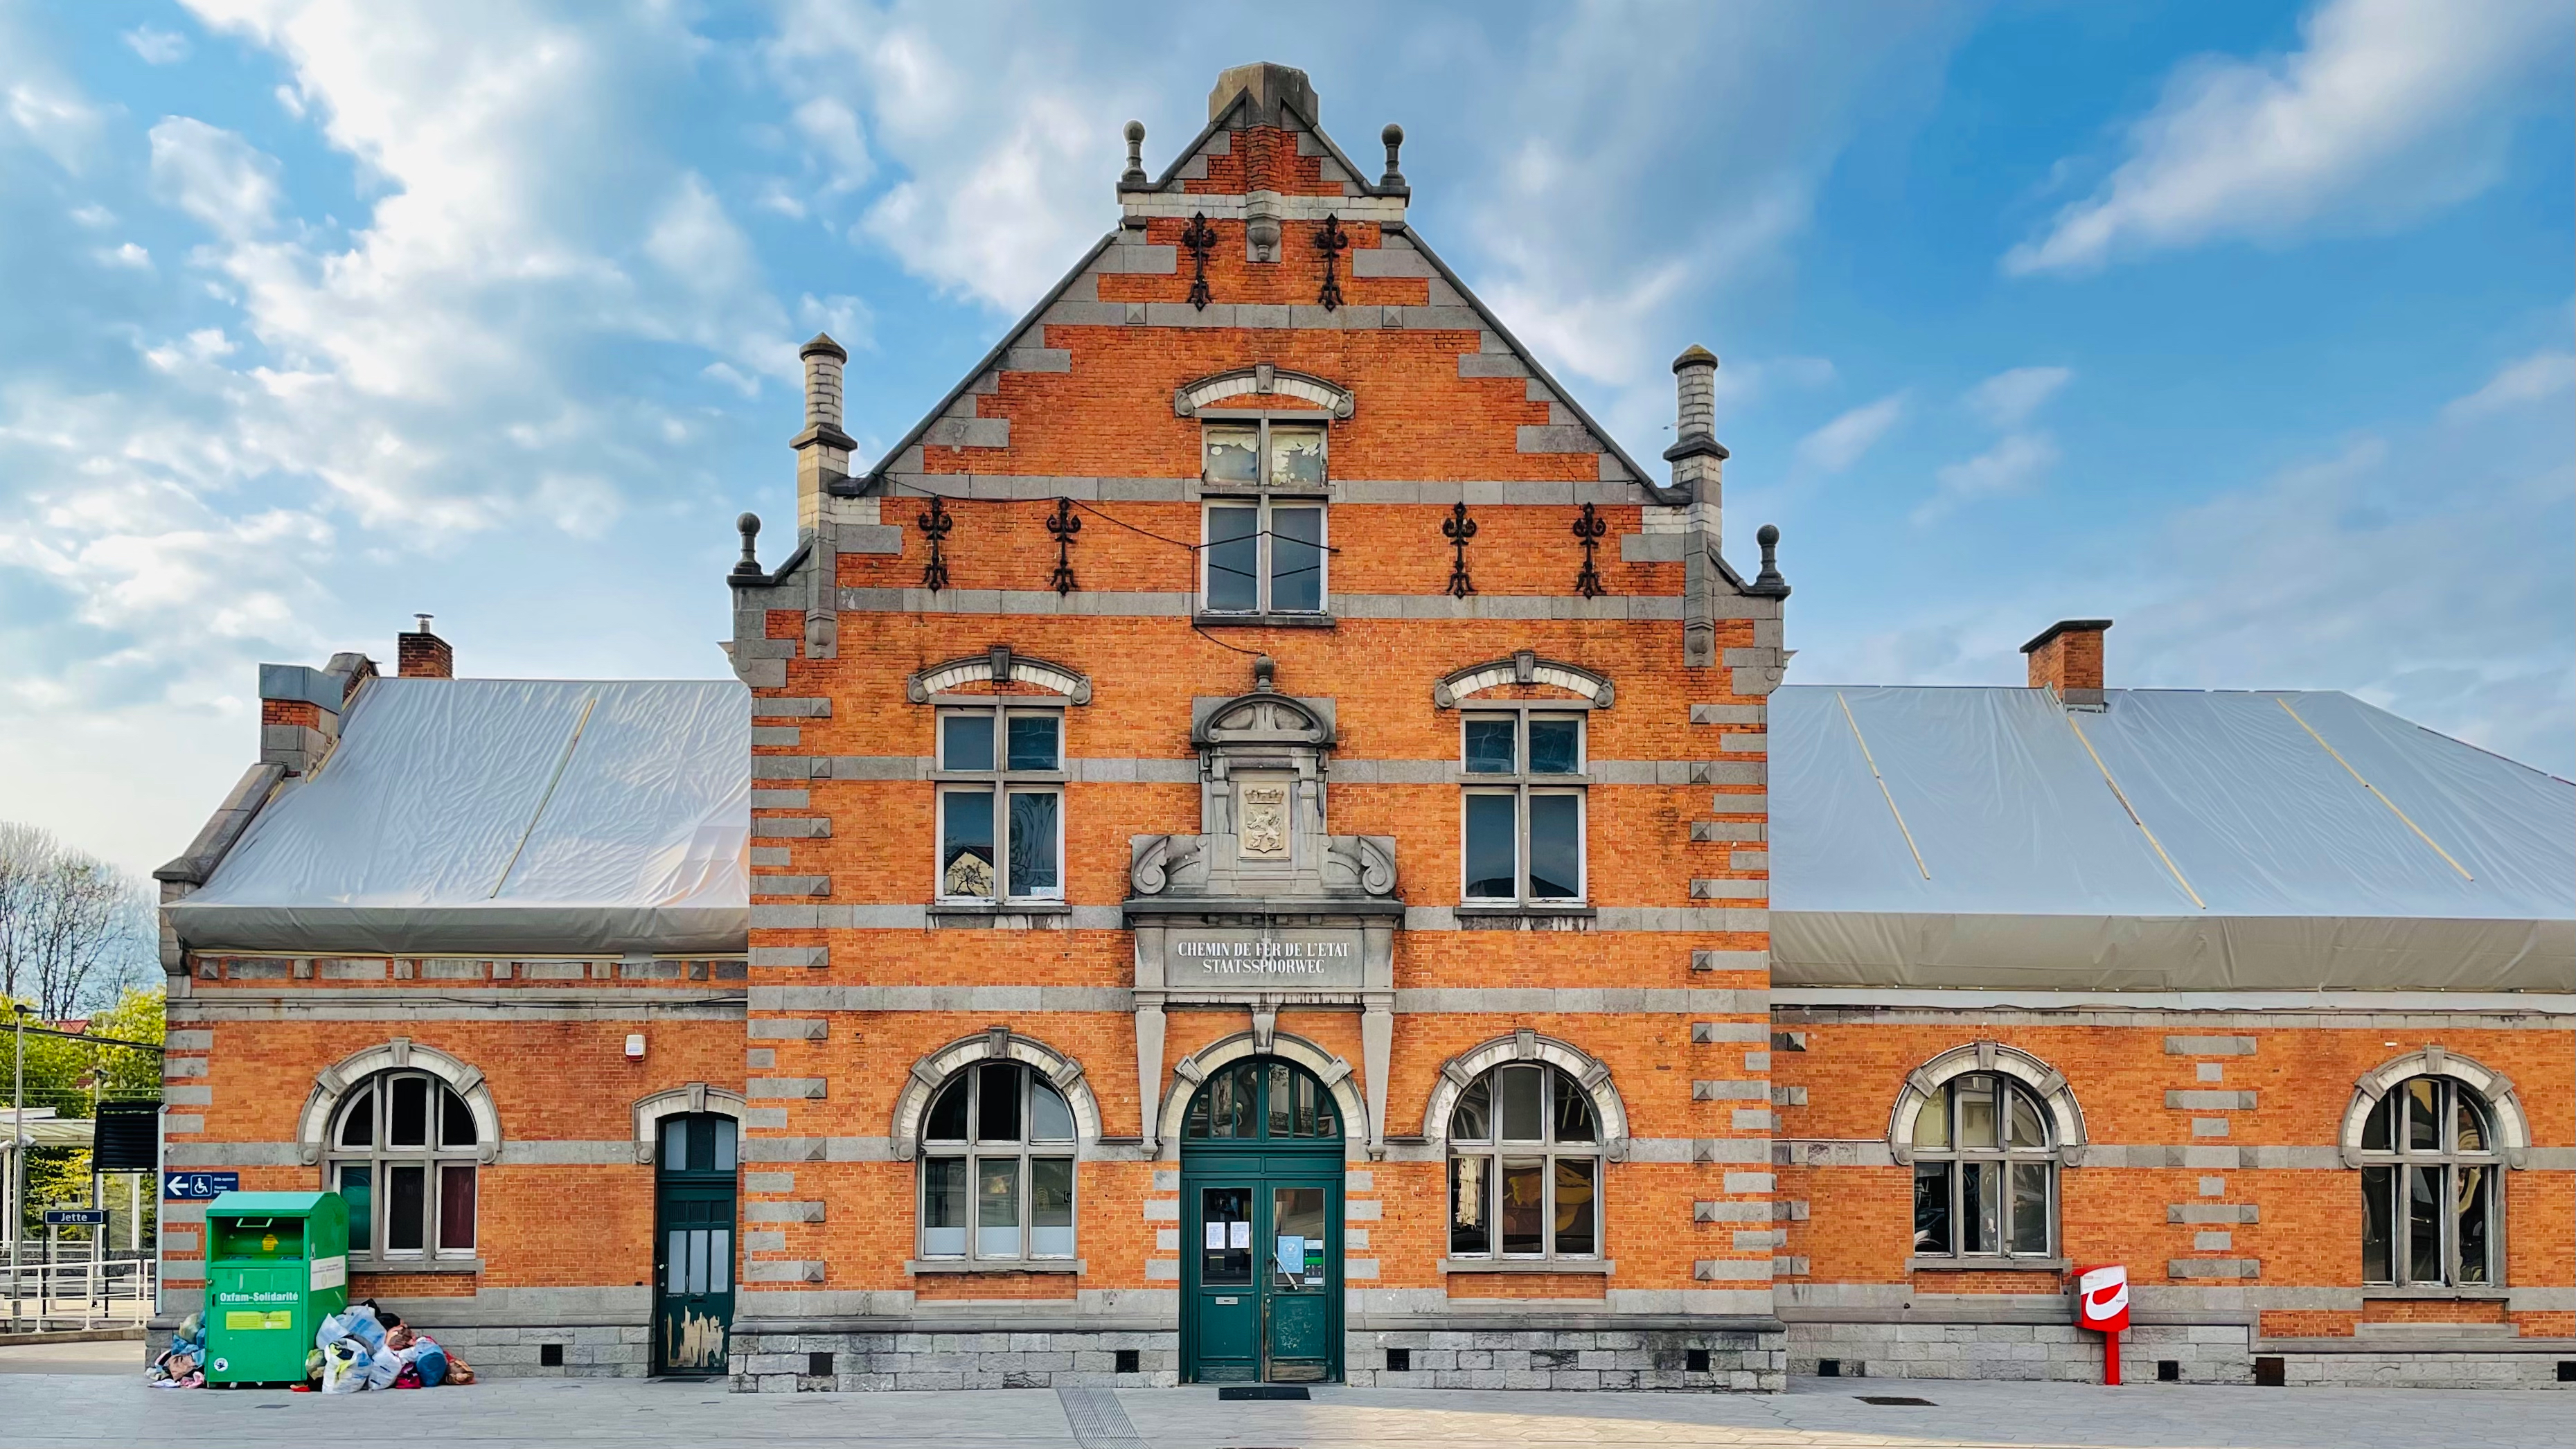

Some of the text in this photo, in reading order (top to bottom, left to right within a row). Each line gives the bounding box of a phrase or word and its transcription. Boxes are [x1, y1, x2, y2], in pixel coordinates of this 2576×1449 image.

[1178, 942, 1349, 957] CHEMIN DE FER DE L'ETAT
[61, 1213, 87, 1221] Jette
[220, 1292, 298, 1301] Oxfam-Solidarité
